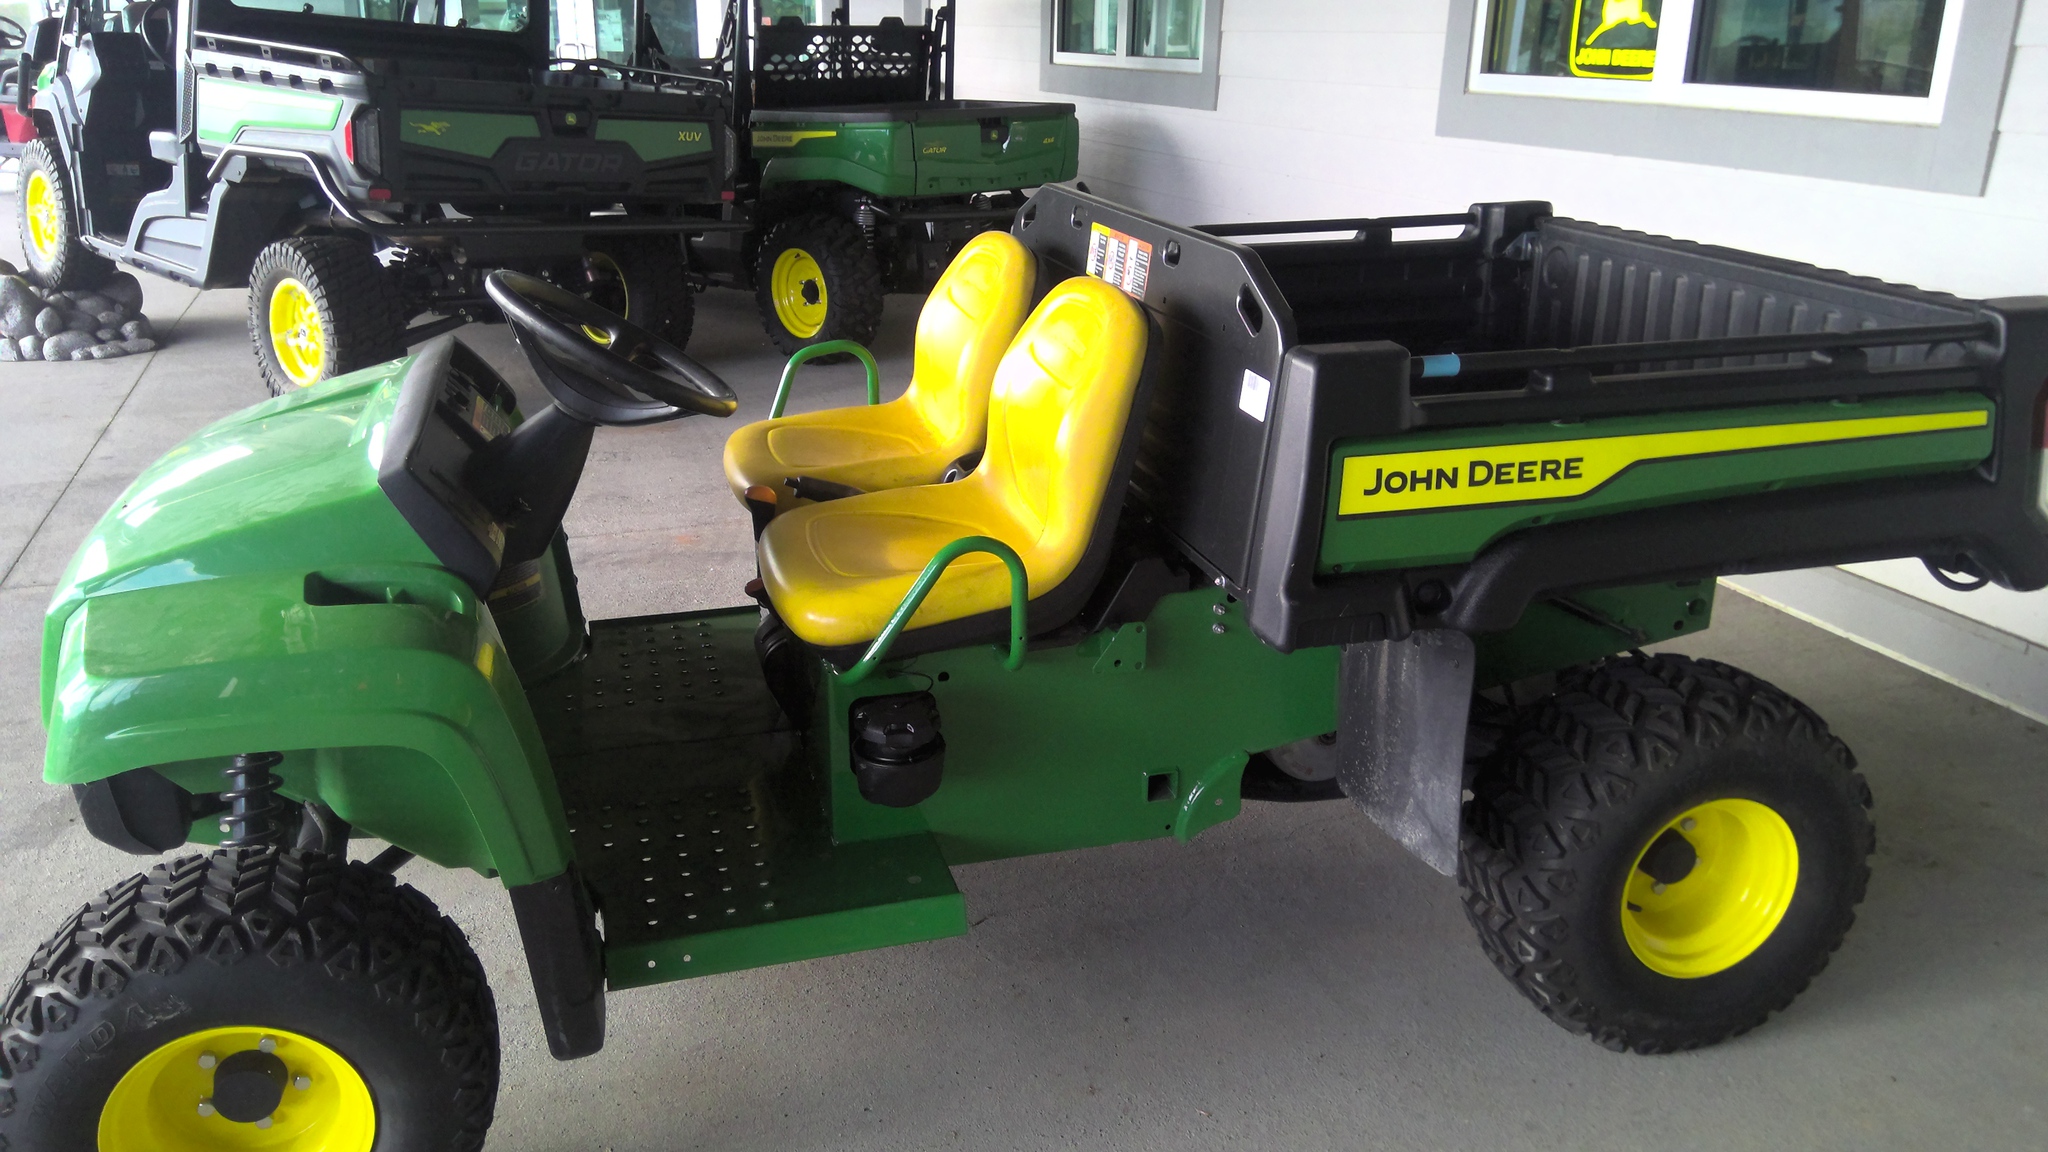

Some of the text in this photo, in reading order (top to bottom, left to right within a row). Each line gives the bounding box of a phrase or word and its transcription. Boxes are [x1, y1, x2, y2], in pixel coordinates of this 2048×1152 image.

[1576, 48, 1656, 67] JOHN DEERE
[678, 131, 702, 141] XUV
[514, 151, 624, 173] GATOR
[1363, 457, 1584, 496] JOHN DEERE
